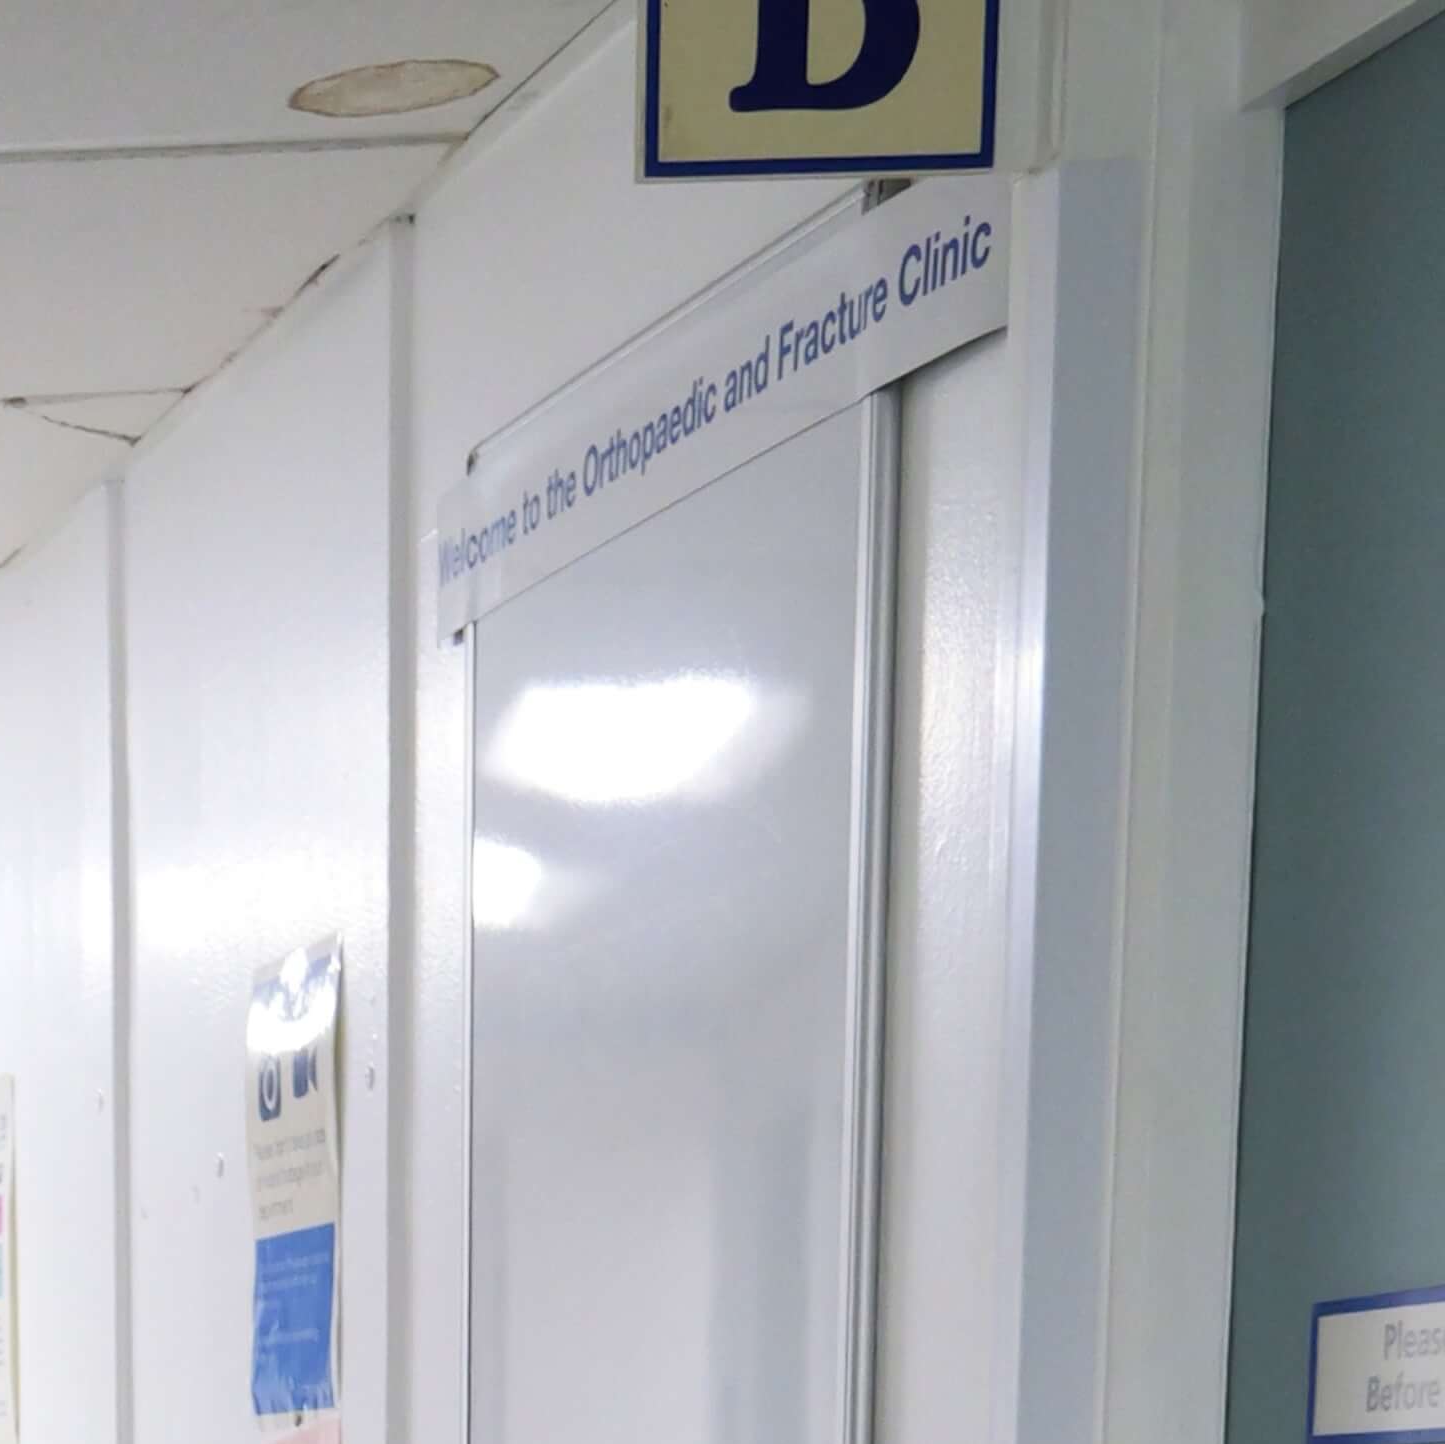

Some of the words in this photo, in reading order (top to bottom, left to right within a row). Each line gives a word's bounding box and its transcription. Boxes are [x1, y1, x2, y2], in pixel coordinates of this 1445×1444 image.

[437, 508, 517, 587] Welcome
[522, 490, 540, 535] to
[546, 469, 577, 520] the
[582, 375, 718, 497] Orthopaedic
[723, 334, 771, 413] and
[776, 276, 888, 382] Fracture
[898, 214, 992, 307] Clinic
[1383, 1319, 1445, 1361] Pleas
